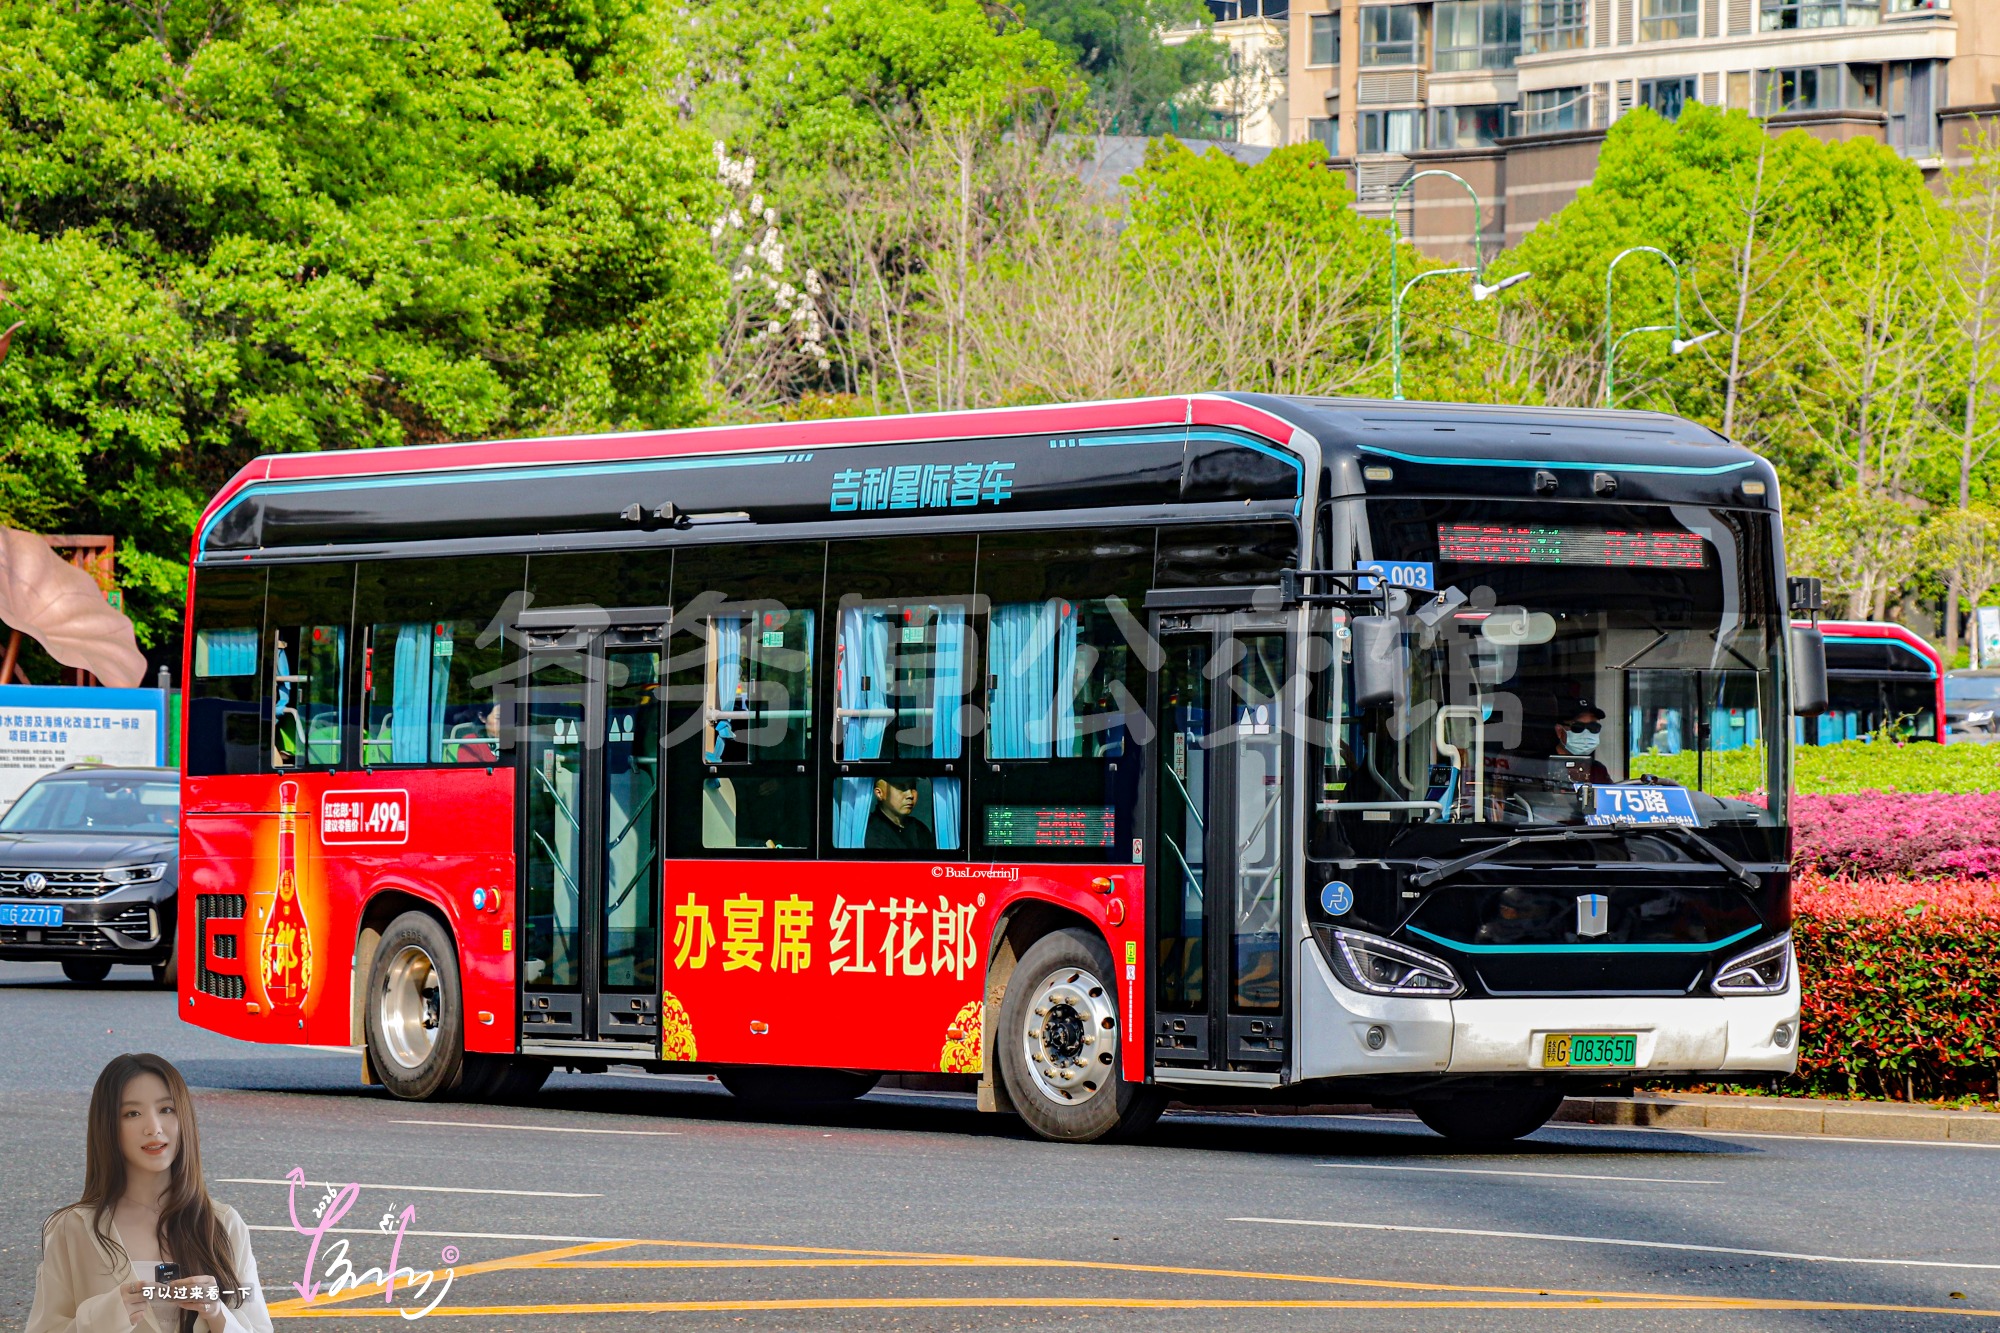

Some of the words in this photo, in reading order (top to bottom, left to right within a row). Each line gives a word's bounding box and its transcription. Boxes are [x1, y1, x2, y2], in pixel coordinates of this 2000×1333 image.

[830, 461, 1016, 512] 吉利星际客车
[1391, 566, 1428, 587] 003
[9, 730, 68, 743] 项目施工通告
[1605, 789, 1669, 813] 75路
[324, 819, 359, 832] 建议零售价
[673, 892, 815, 974] 办宴席
